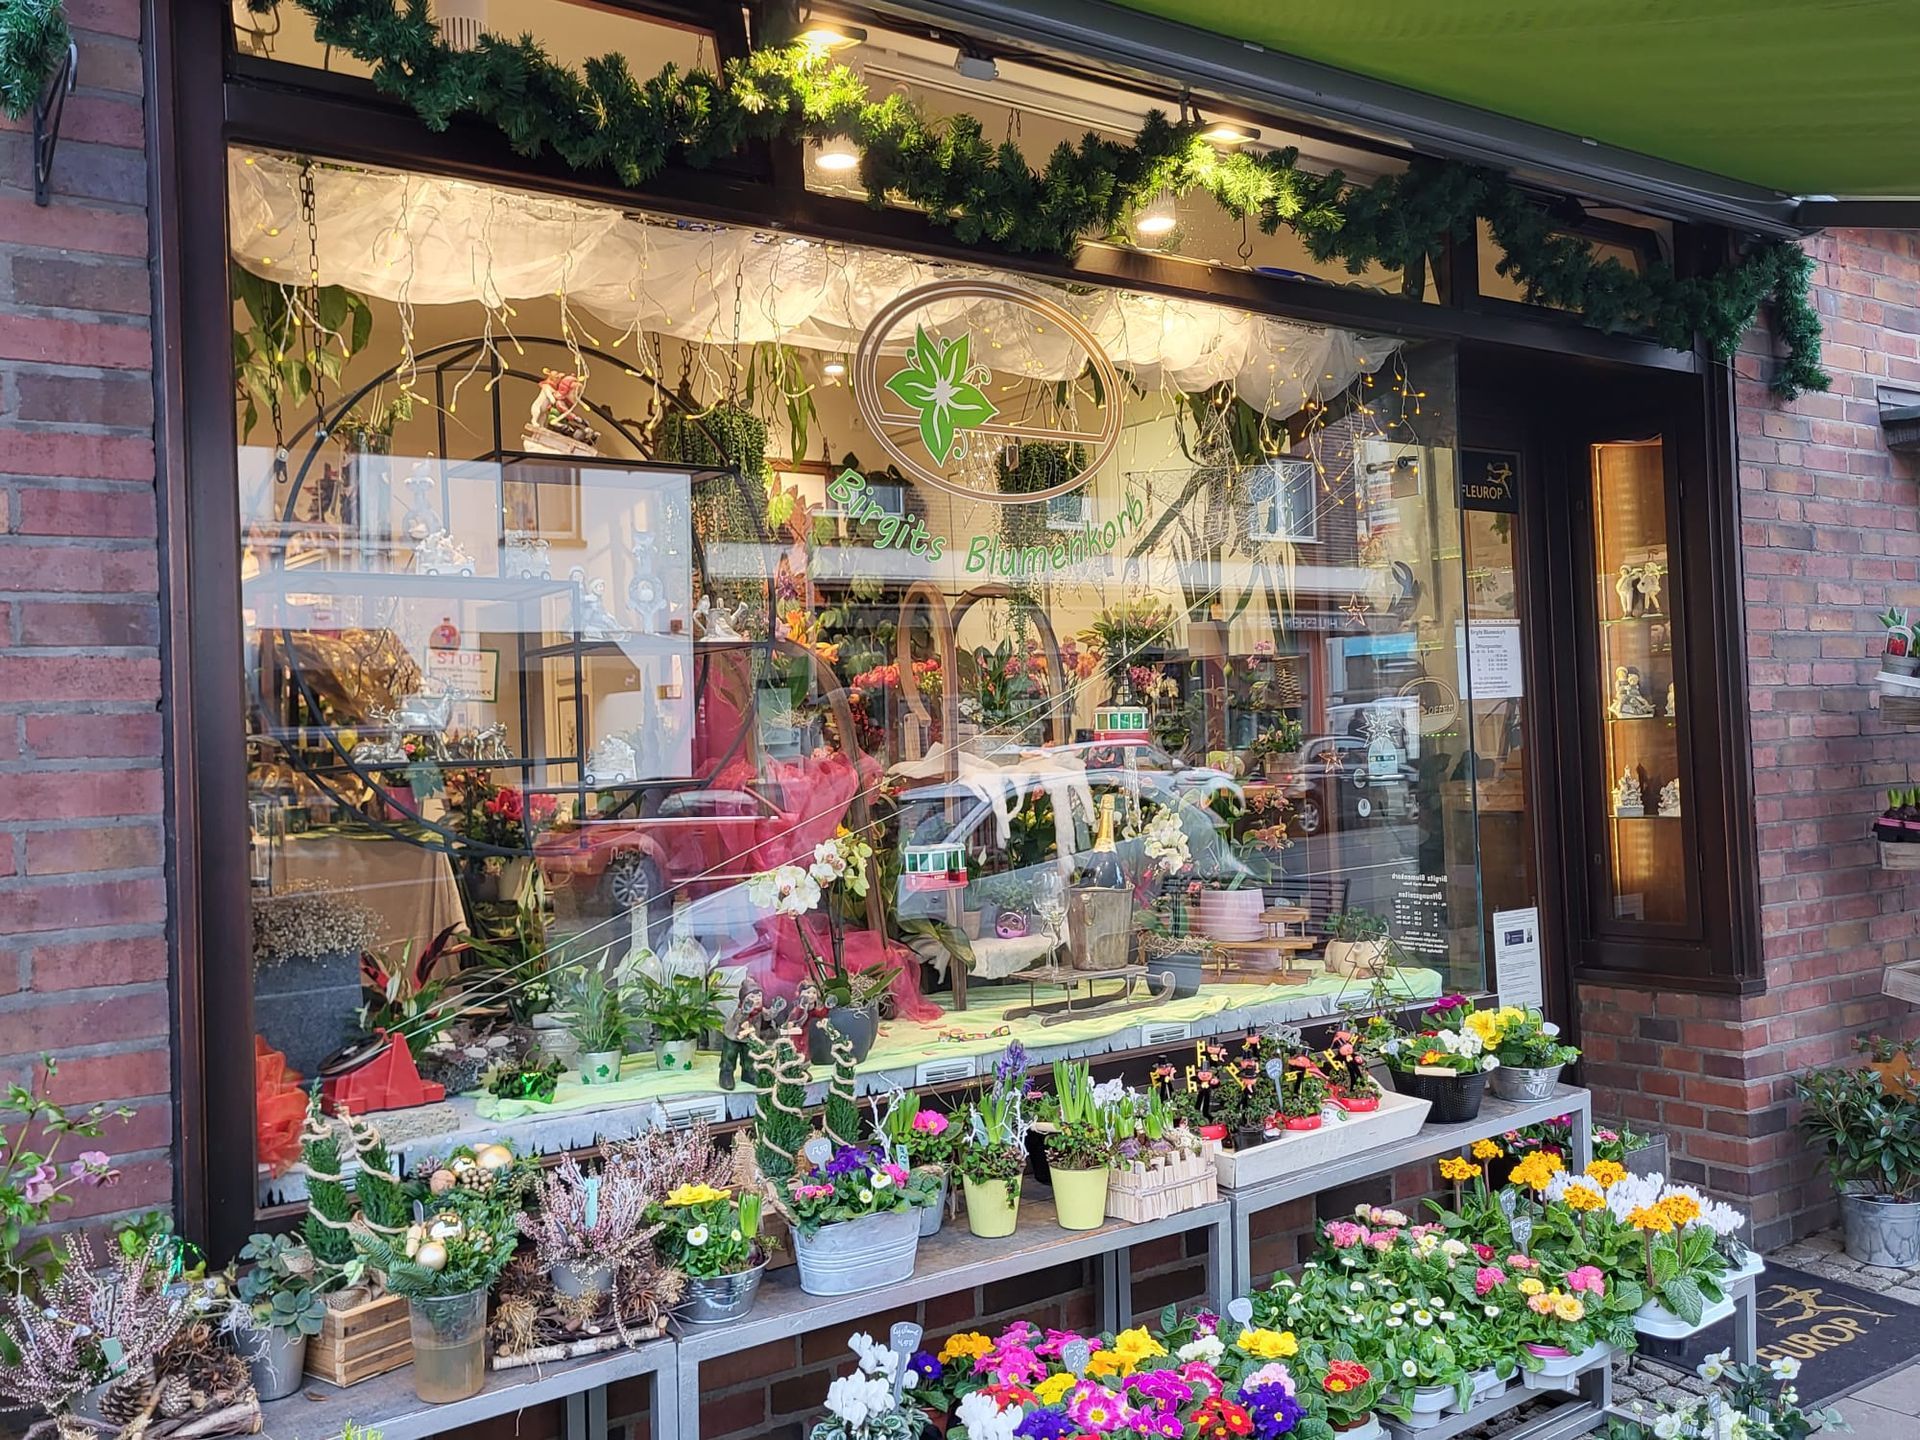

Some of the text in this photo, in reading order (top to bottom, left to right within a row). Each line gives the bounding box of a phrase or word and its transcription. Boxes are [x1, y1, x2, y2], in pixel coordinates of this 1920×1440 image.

[827, 468, 1144, 577] Birgits Blumenkorb
[437, 651, 483, 666] STOP
[1756, 1317, 1868, 1372] EUROP
